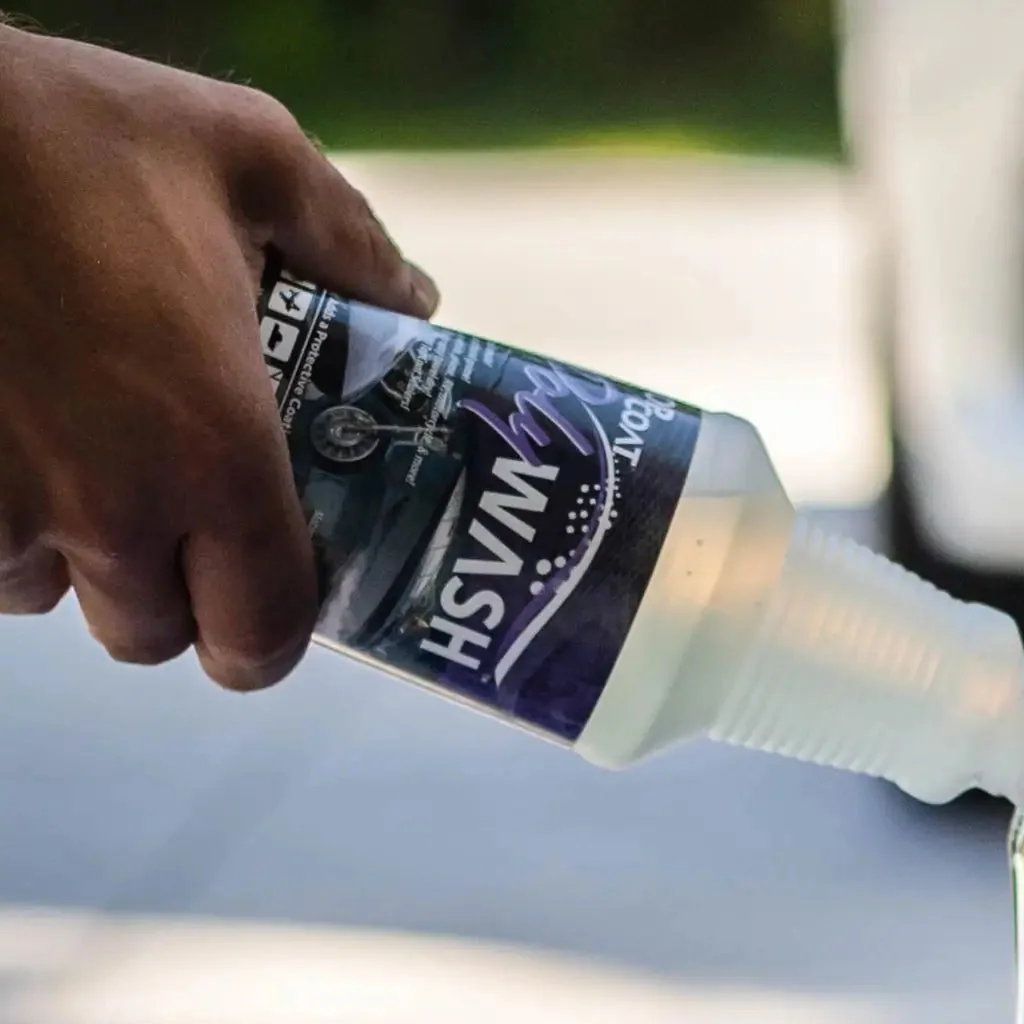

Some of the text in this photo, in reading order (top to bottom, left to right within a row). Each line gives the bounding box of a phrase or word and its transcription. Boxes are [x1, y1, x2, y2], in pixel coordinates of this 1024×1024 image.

[318, 320, 329, 329] a
[294, 329, 328, 397] Protective
[613, 397, 653, 467] COAT
[405, 454, 423, 487] more!
[420, 457, 560, 670] WASH
